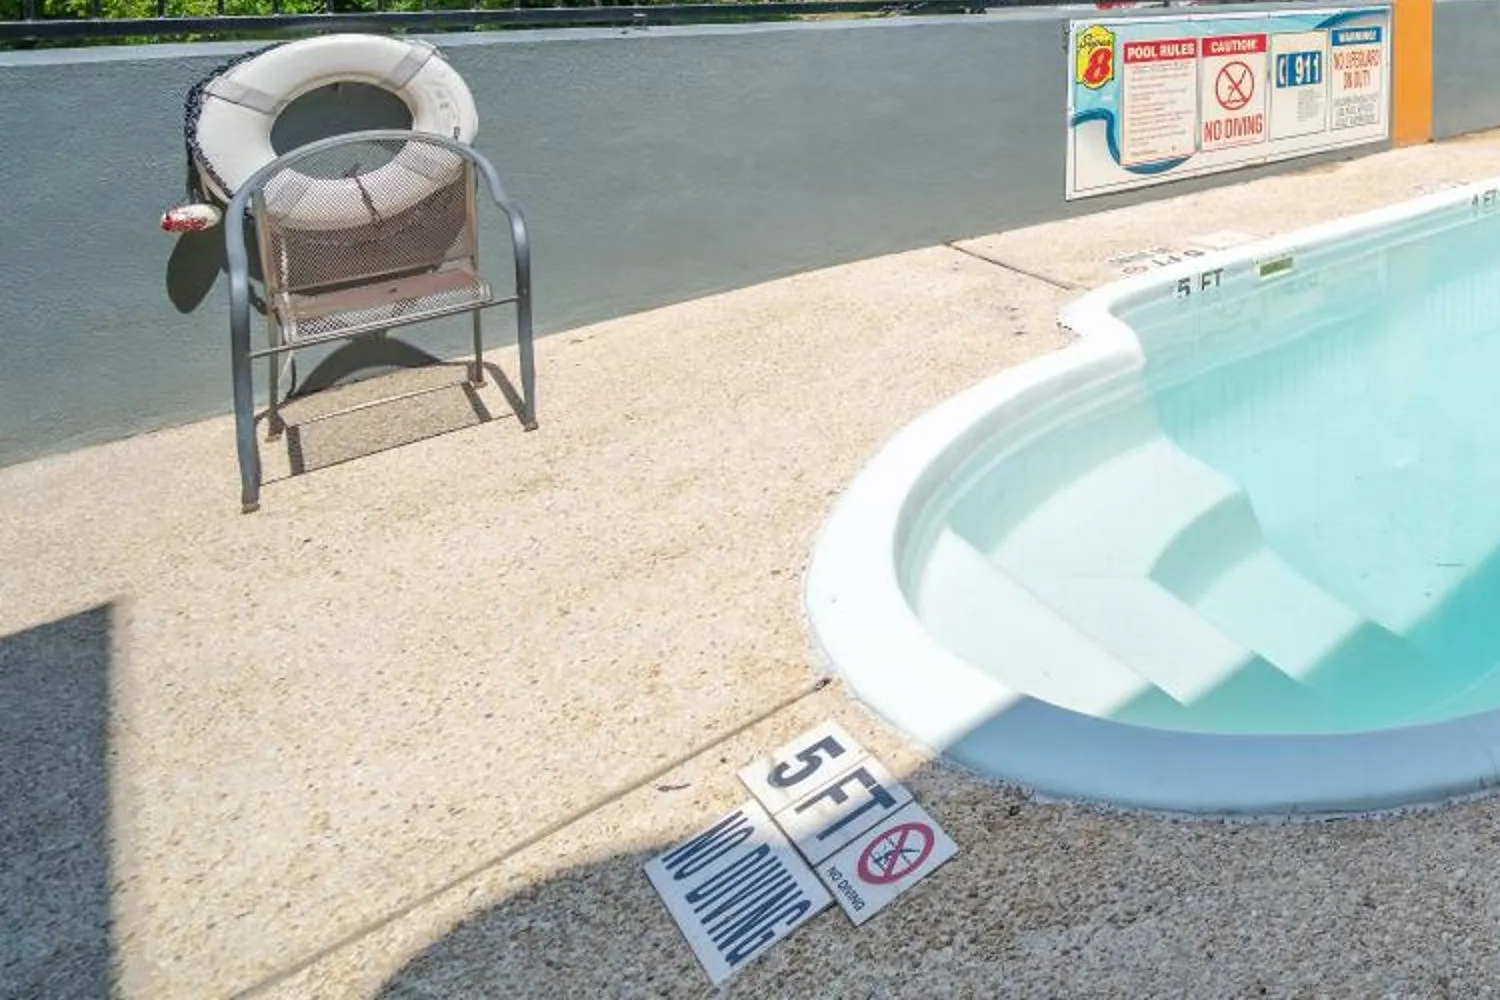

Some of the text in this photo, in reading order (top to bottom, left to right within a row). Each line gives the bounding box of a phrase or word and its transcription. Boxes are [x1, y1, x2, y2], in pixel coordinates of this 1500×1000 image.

[1083, 46, 1112, 89] 8
[1127, 42, 1195, 60] POOL RULES
[1295, 54, 1320, 83] 911
[1203, 114, 1263, 142] NO DIVING
[1177, 267, 1224, 298] 5 FT
[767, 735, 846, 788] 5
[794, 765, 897, 841] FT
[661, 809, 811, 967] NO DIVING
[826, 866, 865, 912] NO DIVING
